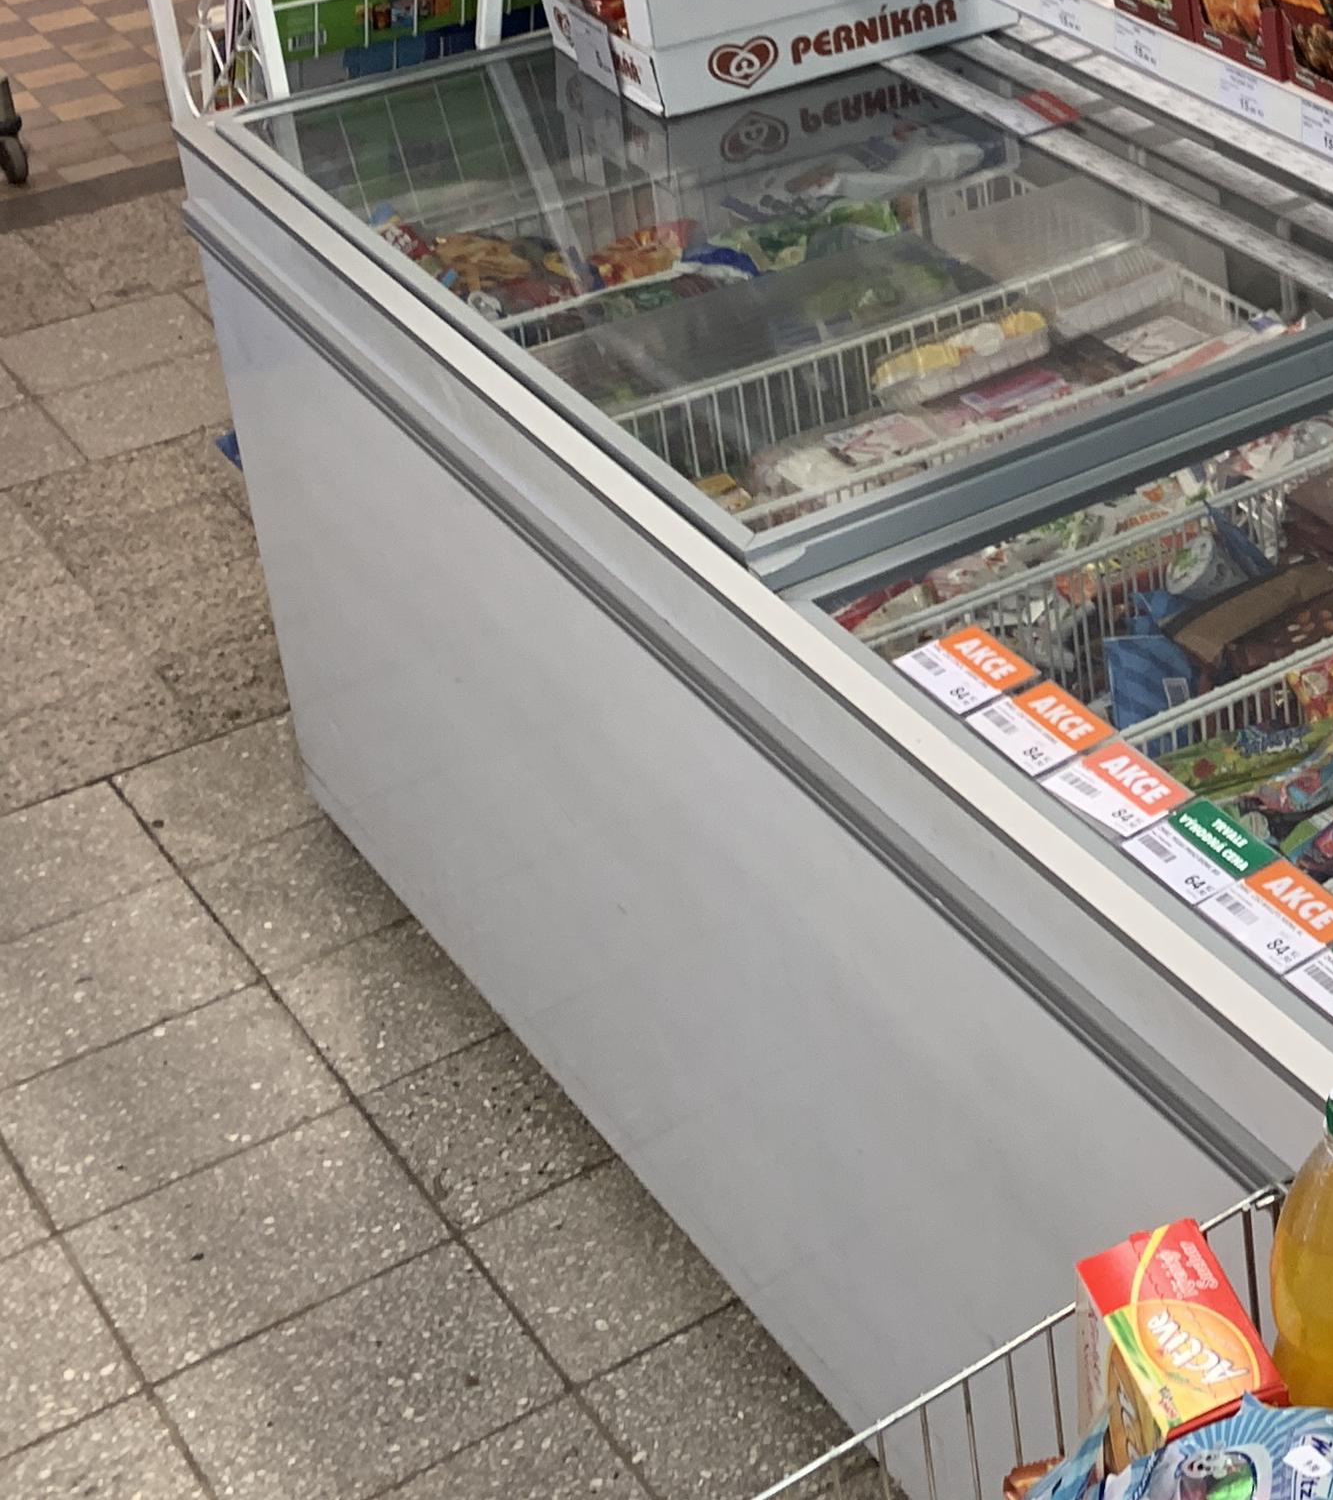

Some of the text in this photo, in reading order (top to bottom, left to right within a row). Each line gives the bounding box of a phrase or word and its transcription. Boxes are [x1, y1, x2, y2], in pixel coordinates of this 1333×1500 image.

[954, 637, 1018, 682] AKCE
[1027, 695, 1095, 742] AKCE
[1099, 754, 1172, 806] AKCE
[1211, 817, 1249, 849] TRVALE
[1220, 844, 1250, 873] CENA
